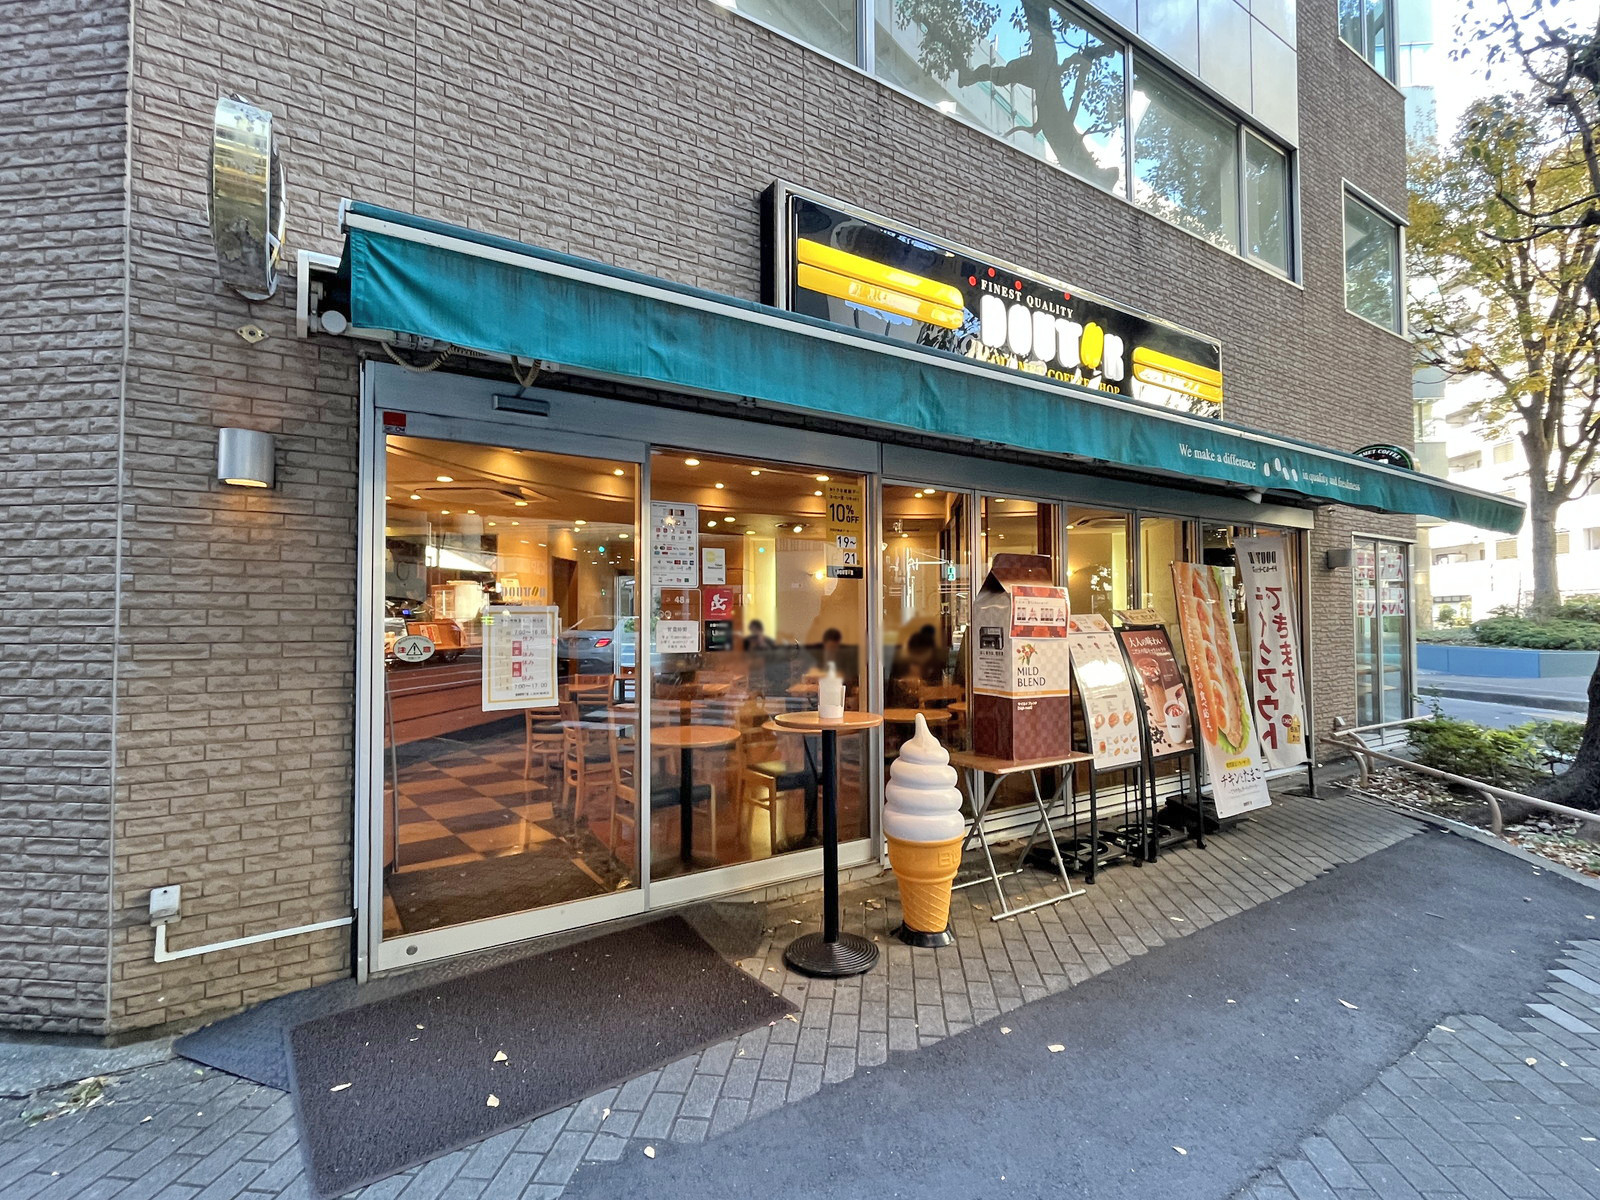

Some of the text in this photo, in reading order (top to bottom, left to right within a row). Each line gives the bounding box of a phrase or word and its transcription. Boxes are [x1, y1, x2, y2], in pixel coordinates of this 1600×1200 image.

[981, 279, 1074, 318] FINEST QUALITY
[980, 294, 1124, 382] DOUTOR
[1378, 448, 1402, 460] COFFEE
[1178, 443, 1192, 458] We
[1194, 449, 1216, 462] make
[1222, 454, 1256, 470] difference
[1302, 469, 1309, 479] in
[1309, 472, 1328, 486] quality
[846, 515, 860, 524] OFF
[844, 552, 856, 564] 21
[1129, 636, 1163, 648] 大人の味わい
[1017, 666, 1039, 676] MILD
[1017, 676, 1046, 688] BLEND
